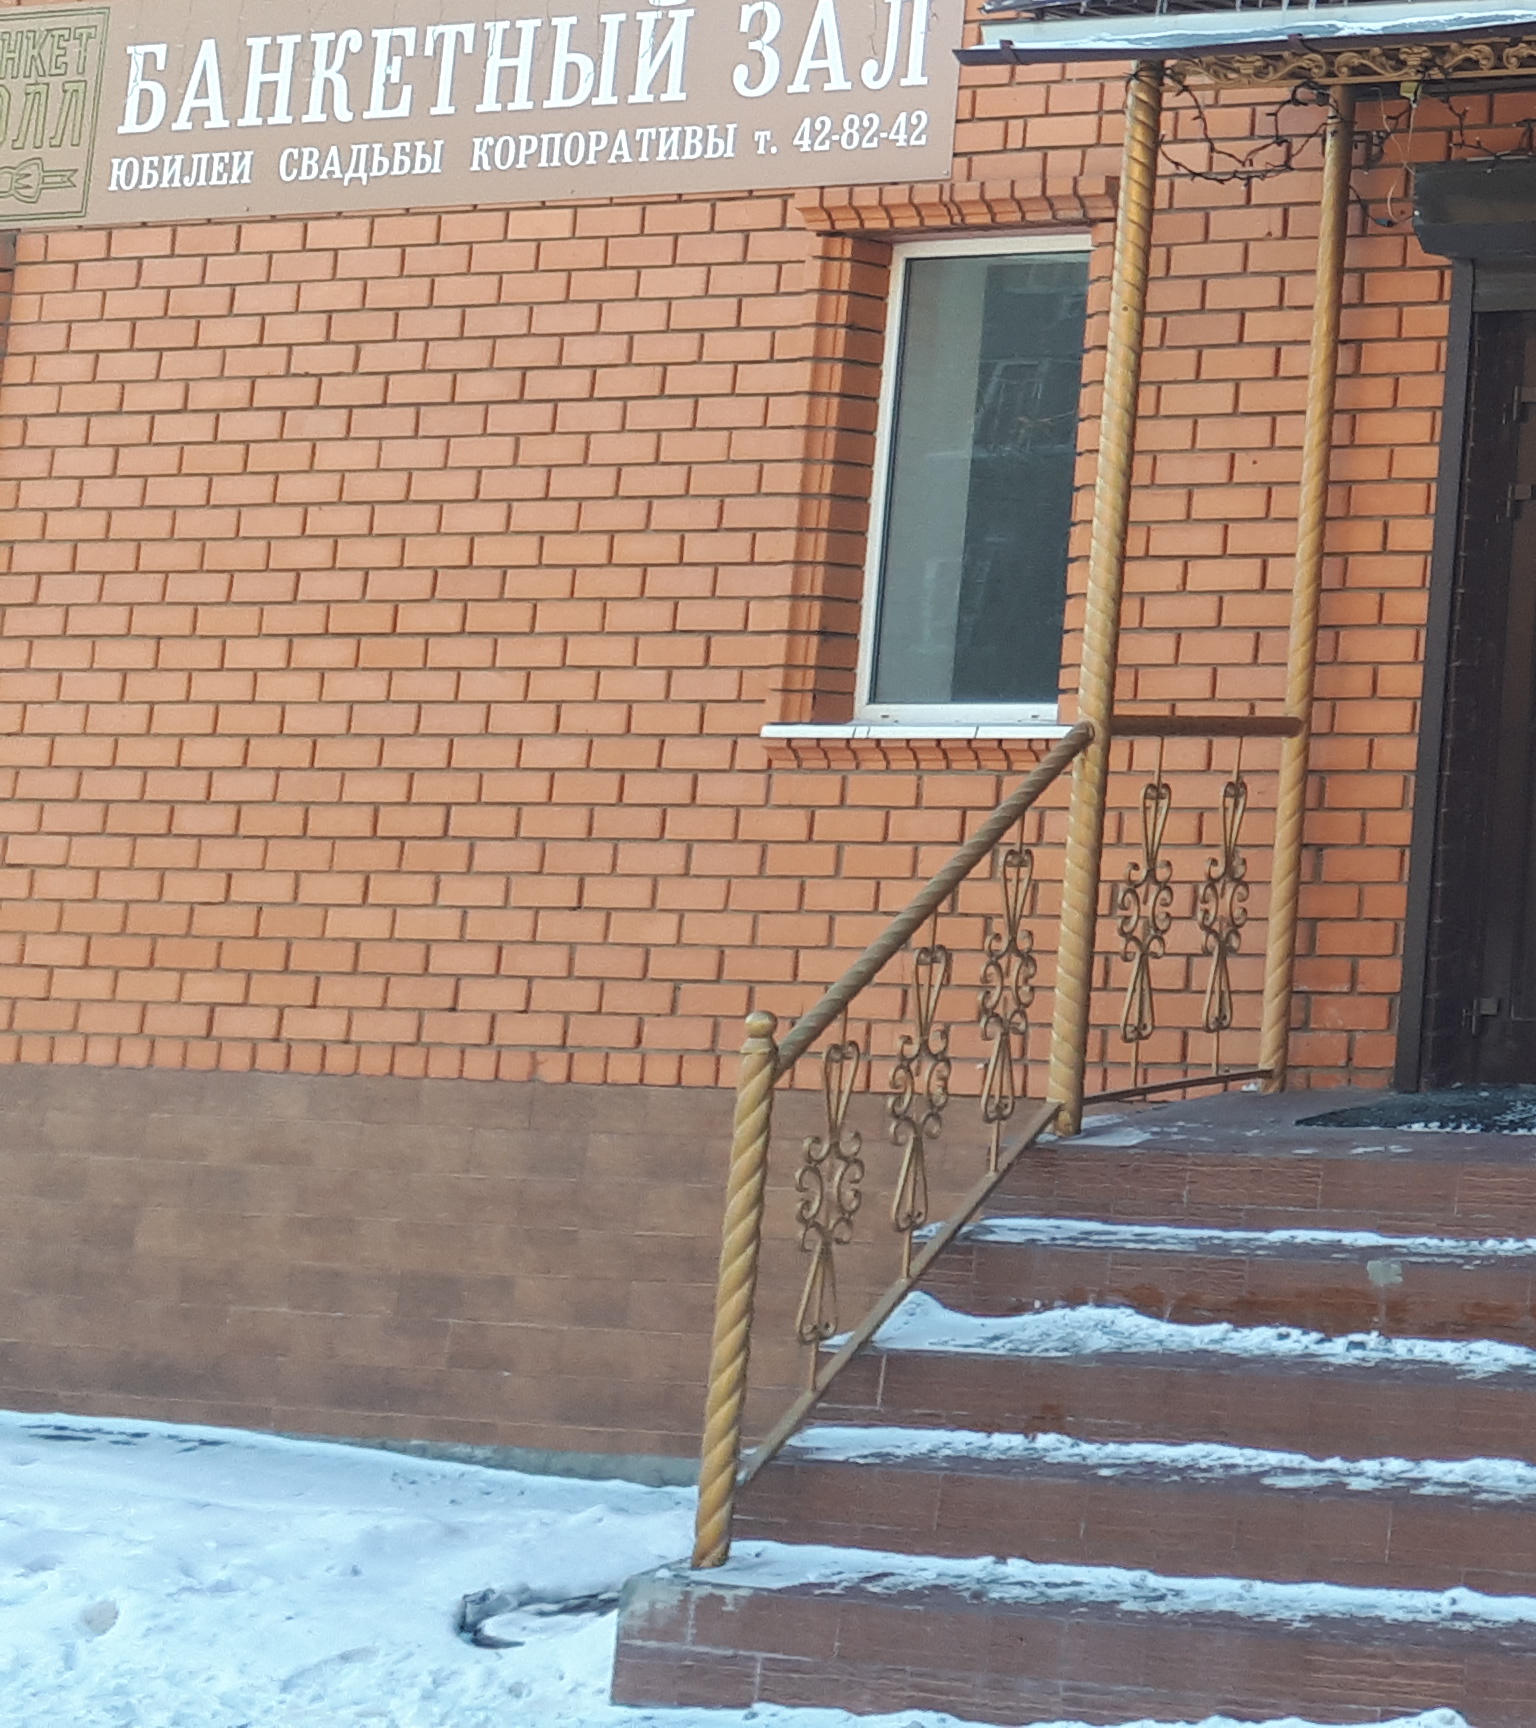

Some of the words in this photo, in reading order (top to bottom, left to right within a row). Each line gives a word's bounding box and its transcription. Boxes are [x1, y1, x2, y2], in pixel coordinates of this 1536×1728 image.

[107, 150, 254, 191] ЮБИЛЕИ
[278, 139, 445, 187] СВАДЬБЫ
[469, 122, 738, 172] КОРПОРАТИВЫ
[753, 129, 779, 156] т.
[792, 109, 928, 154] 42-82-42
